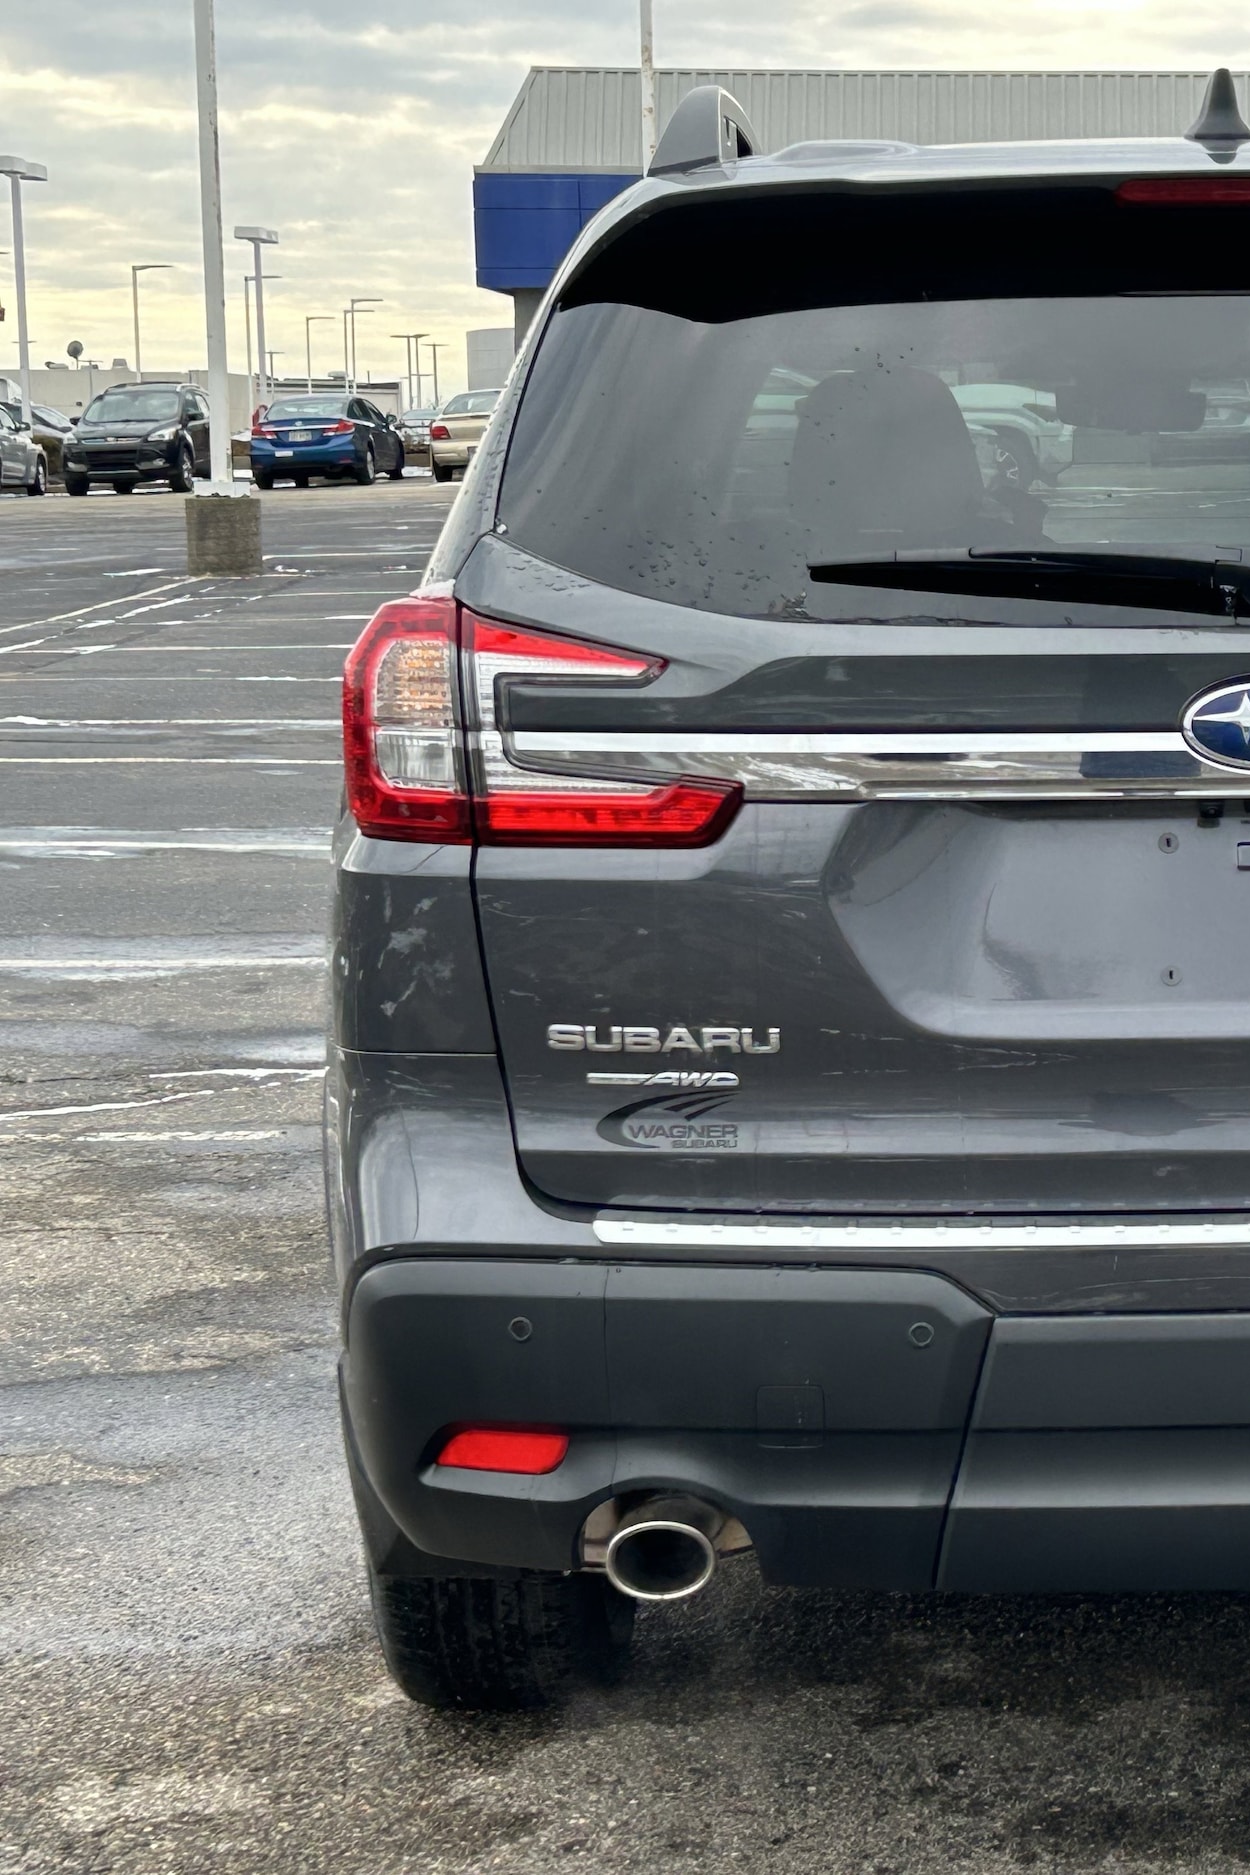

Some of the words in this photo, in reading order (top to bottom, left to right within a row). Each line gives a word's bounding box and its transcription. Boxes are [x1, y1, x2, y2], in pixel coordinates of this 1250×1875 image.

[548, 1024, 781, 1054] SUBARU
[643, 1070, 740, 1088] AWD
[628, 1124, 739, 1139] WAGNER
[671, 1139, 738, 1148] SUBARU
